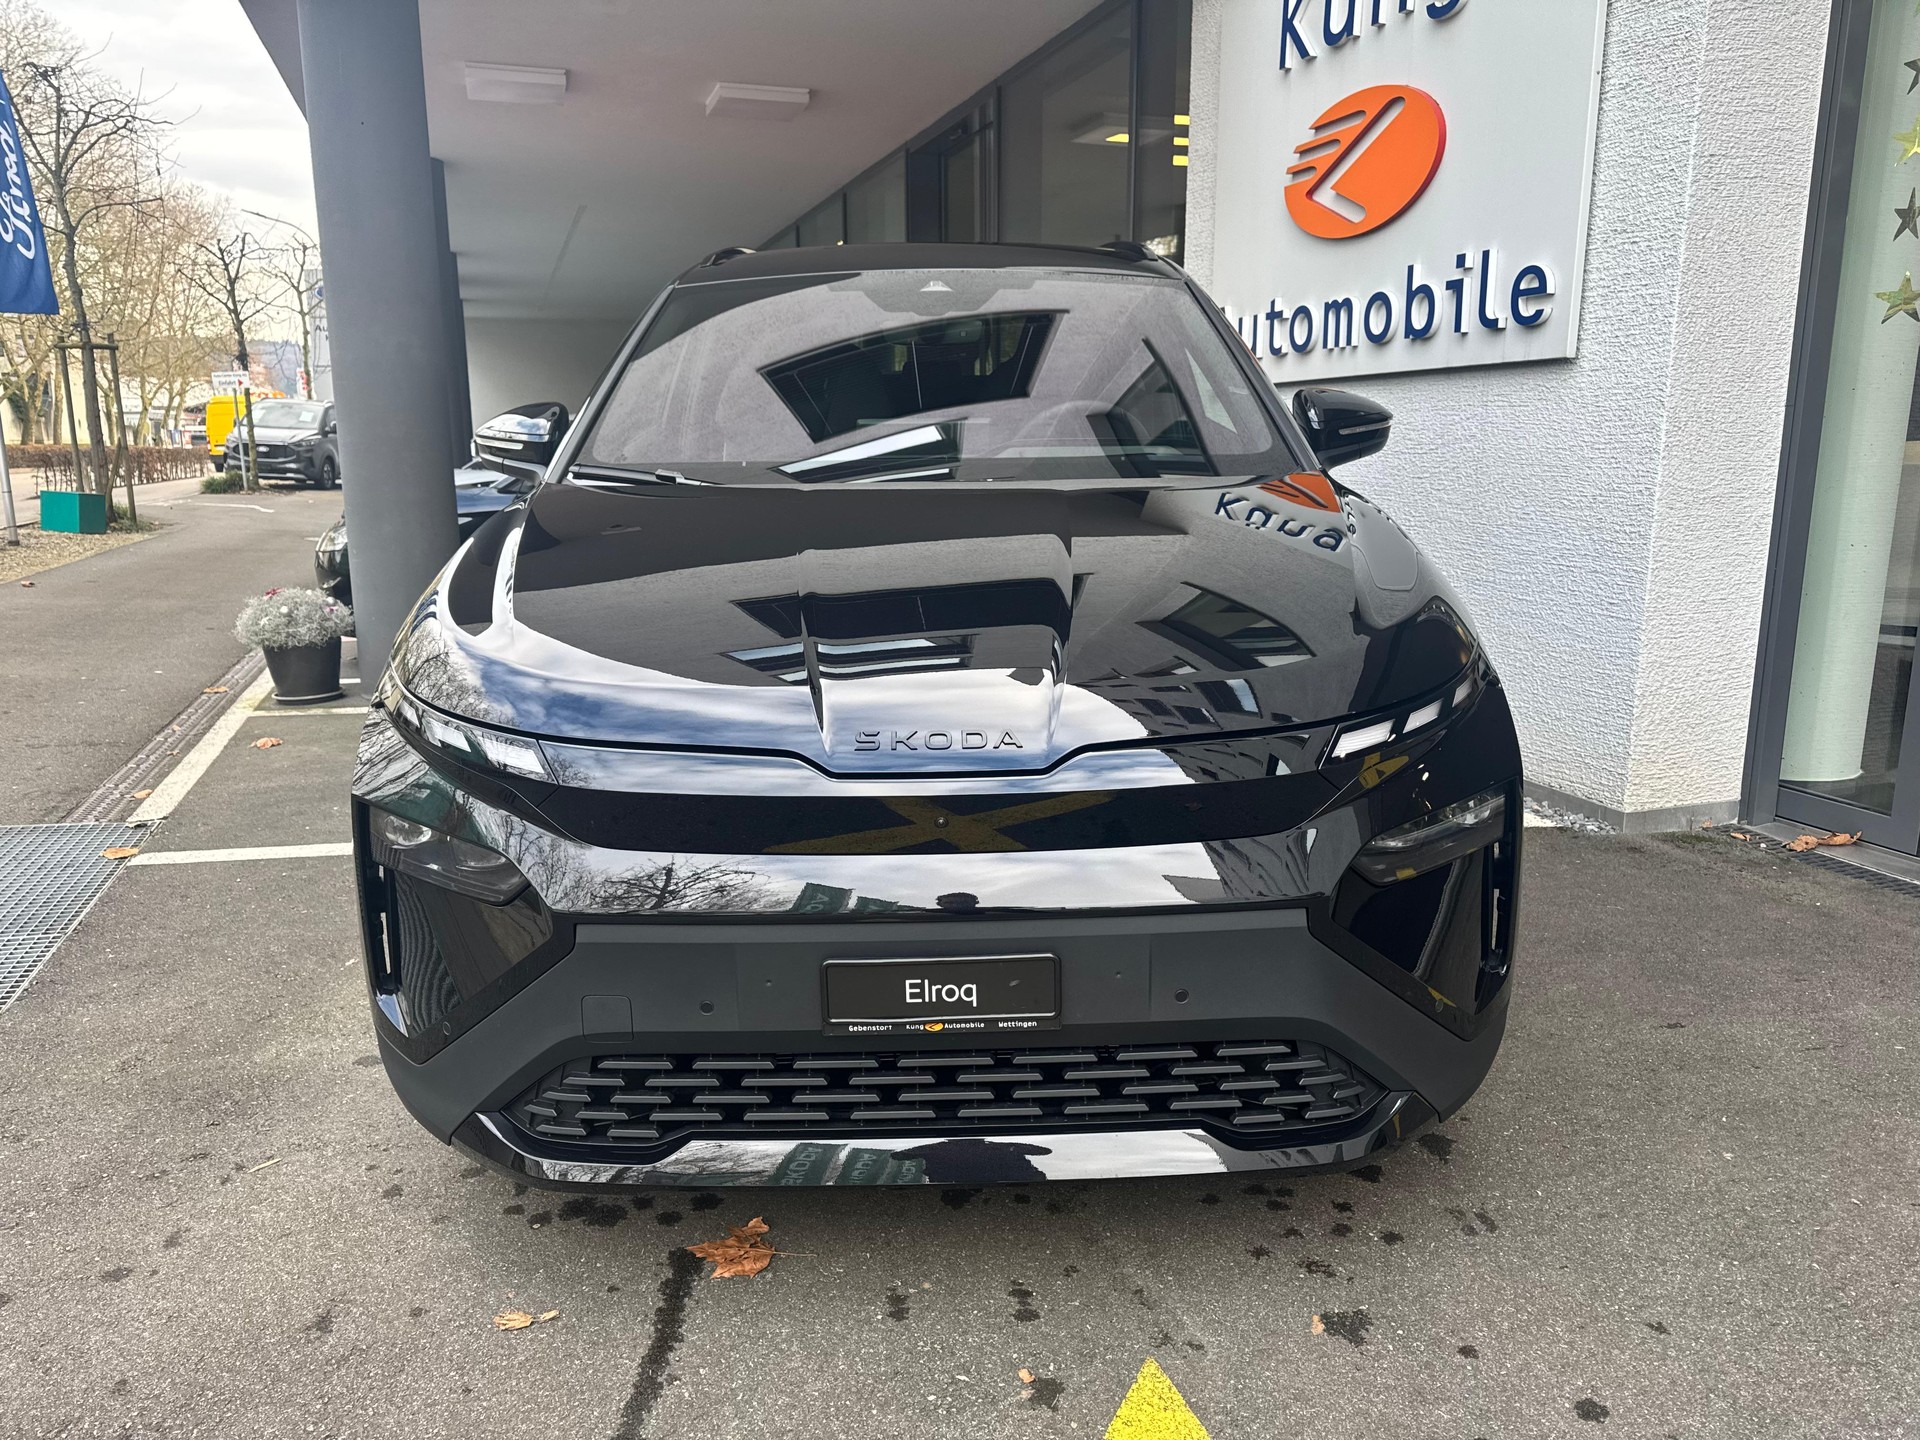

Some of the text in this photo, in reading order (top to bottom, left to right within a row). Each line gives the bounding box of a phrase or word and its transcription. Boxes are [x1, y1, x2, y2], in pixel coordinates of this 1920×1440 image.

[1220, 247, 1556, 359] utomobile
[905, 979, 977, 1007] Elroq
[944, 1021, 985, 1029] Automobile
[998, 1020, 1038, 1028] Wettingen
